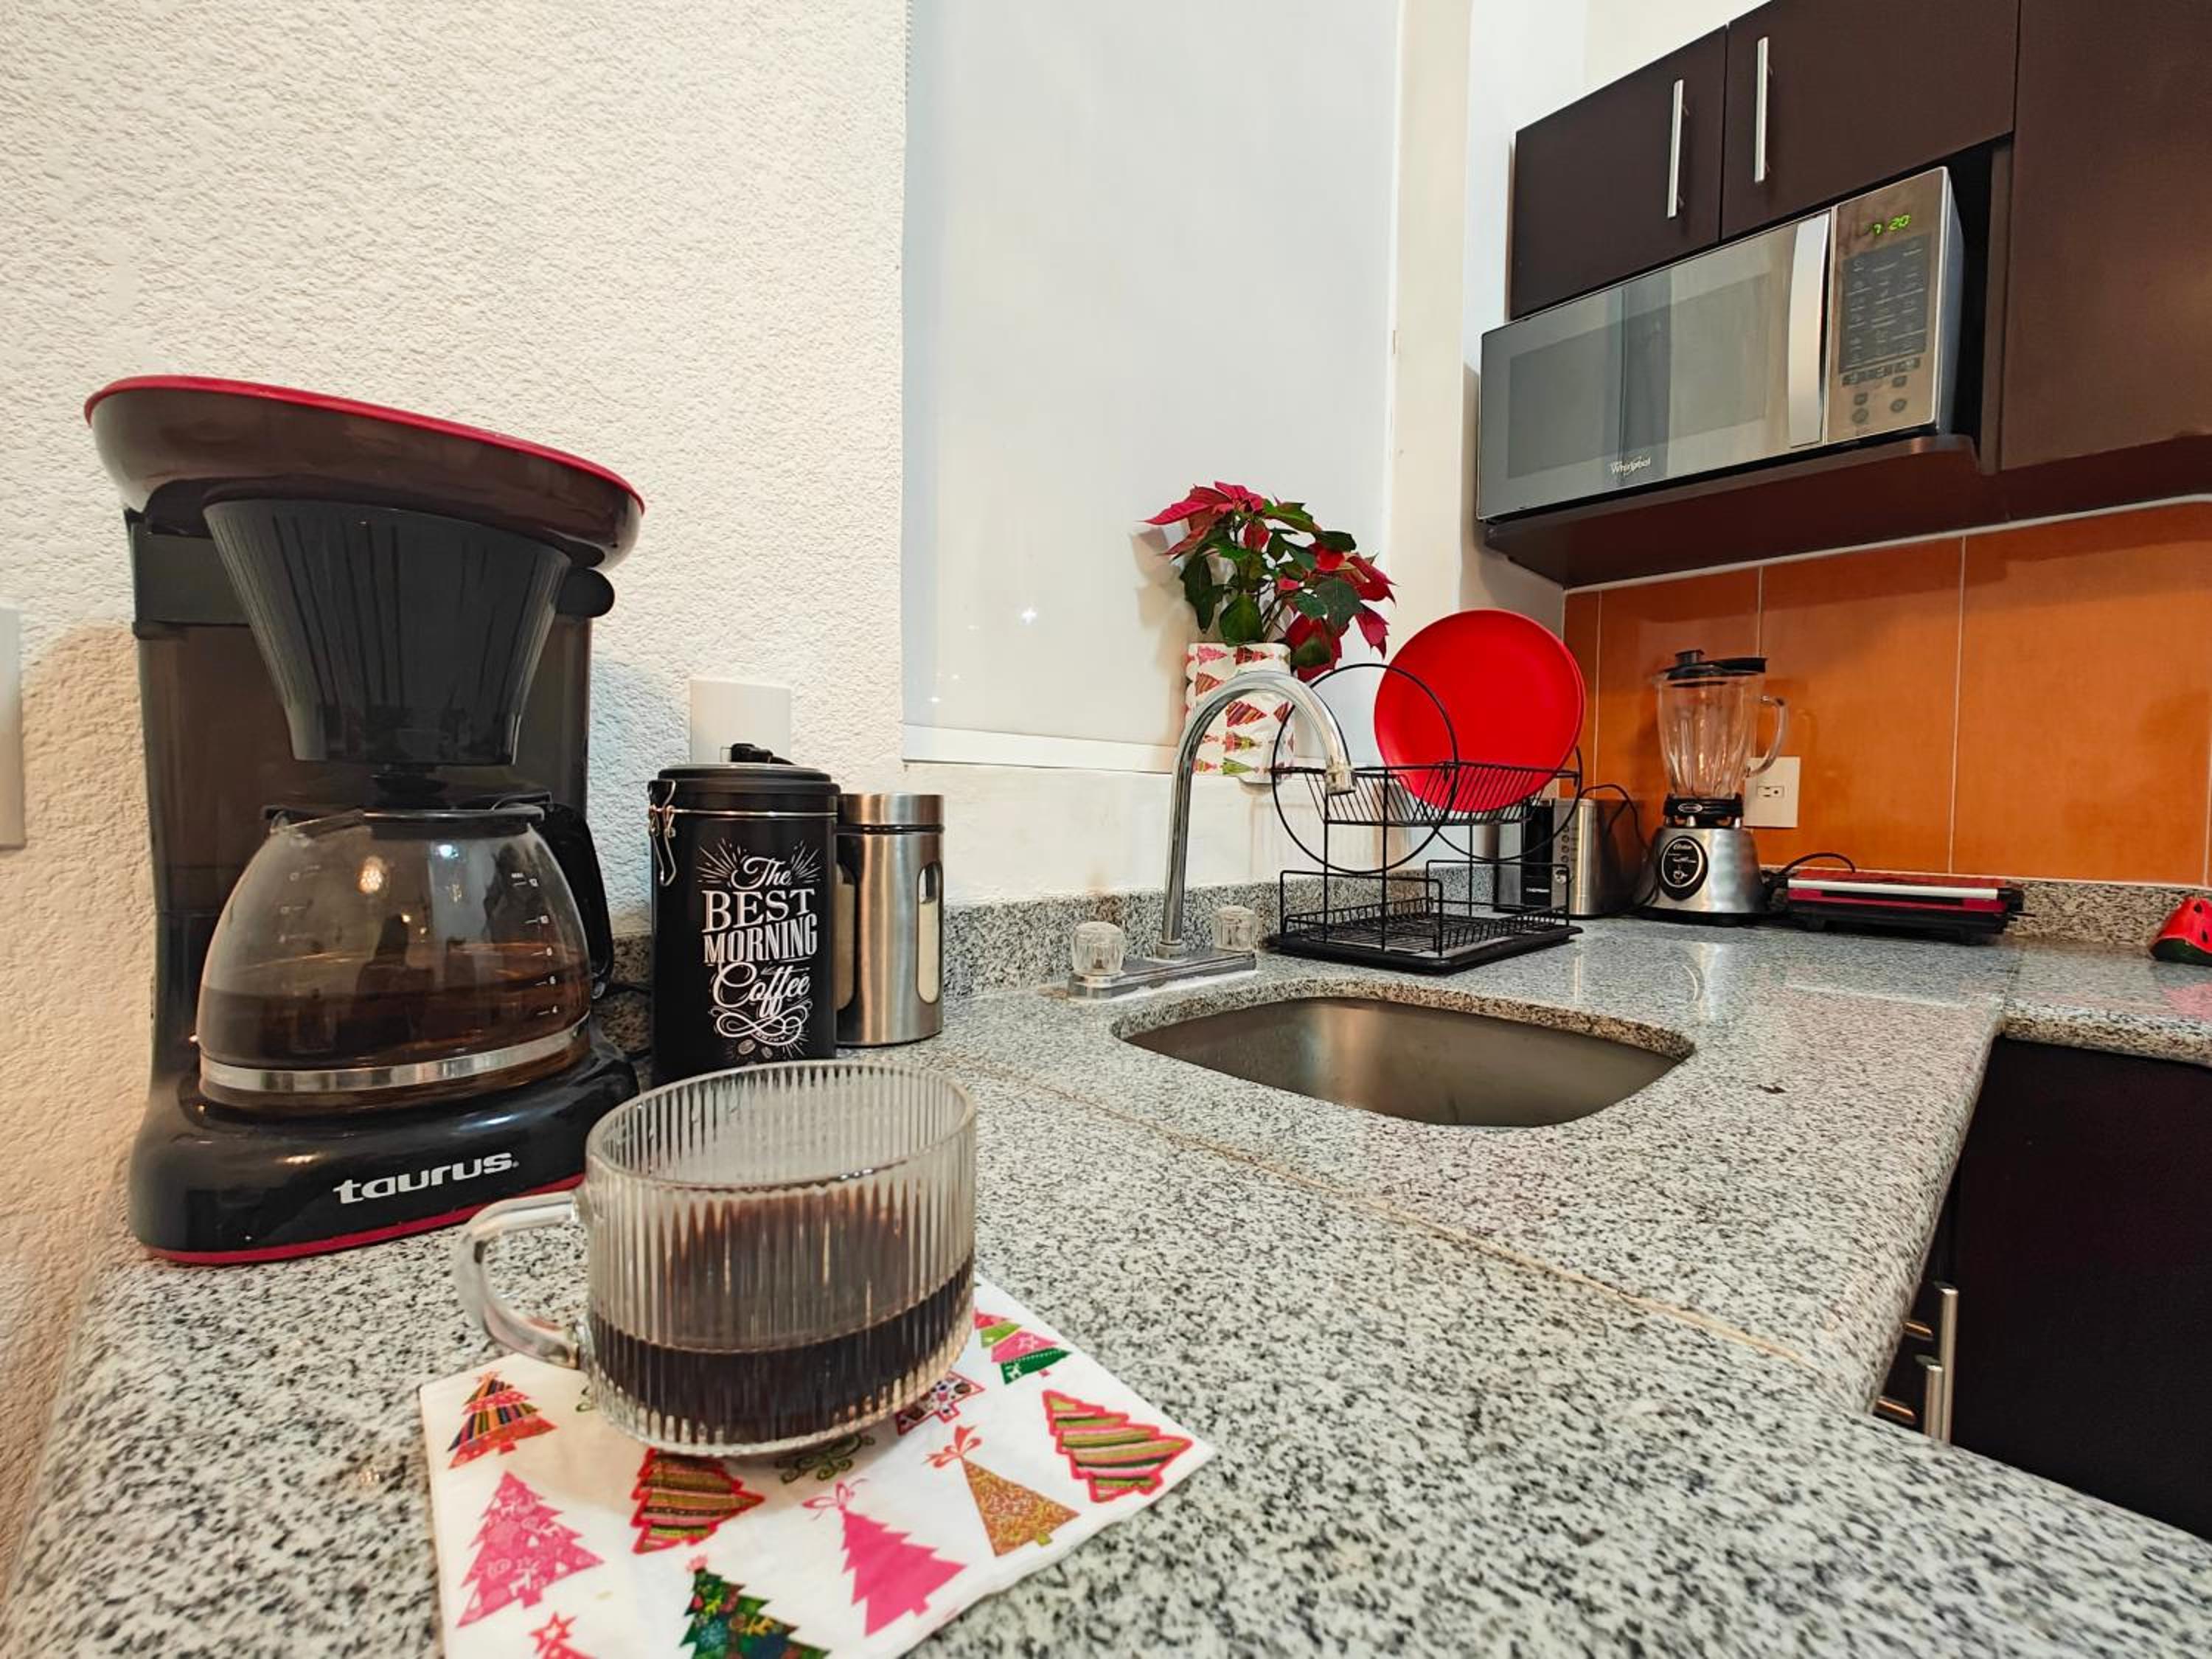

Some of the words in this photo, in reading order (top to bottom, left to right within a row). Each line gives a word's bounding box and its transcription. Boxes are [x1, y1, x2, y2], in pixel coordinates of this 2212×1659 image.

[731, 856, 793, 891] The
[701, 888, 815, 933] BEST
[703, 912, 818, 964] MORNING
[712, 960, 810, 1018] Coffee
[333, 1152, 515, 1204] taurus
